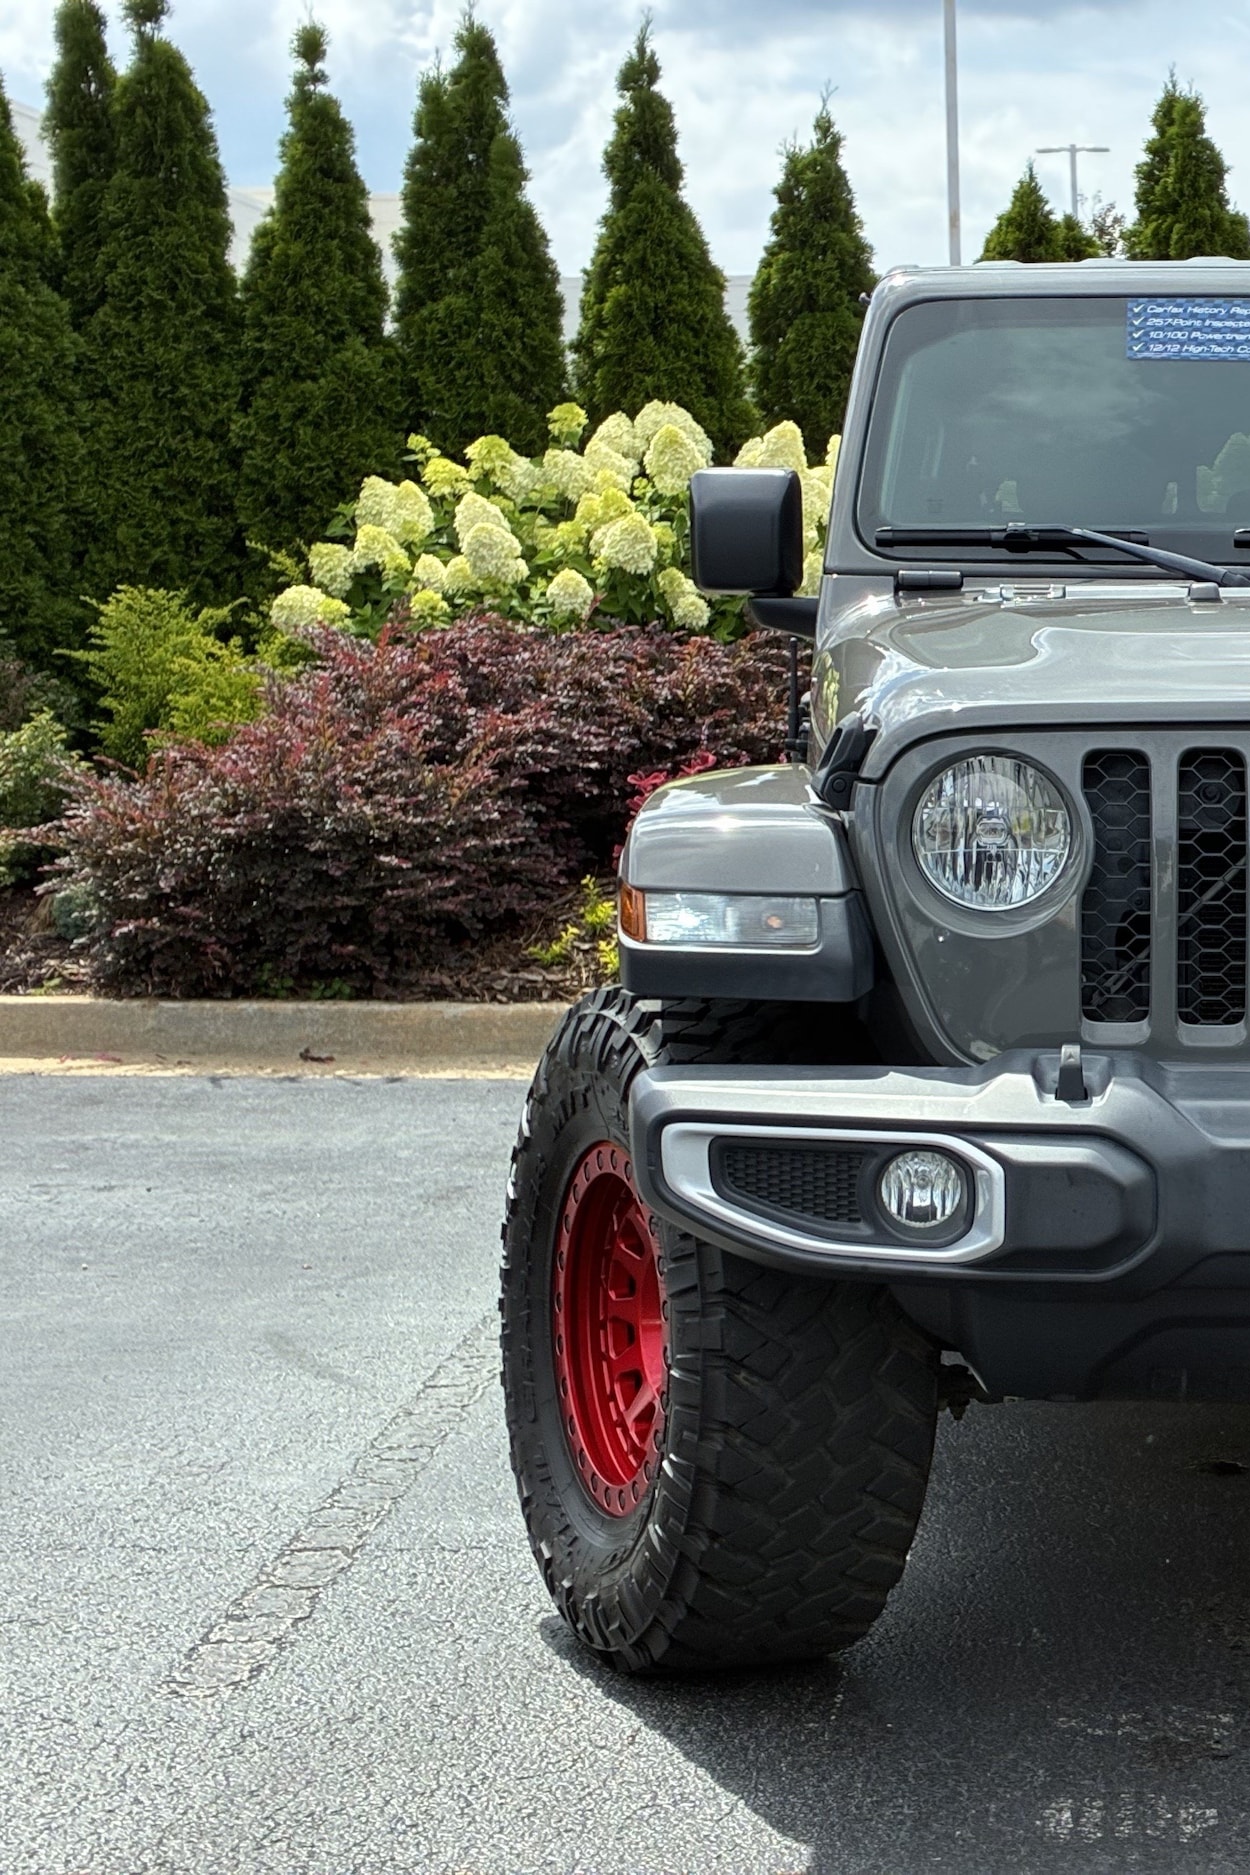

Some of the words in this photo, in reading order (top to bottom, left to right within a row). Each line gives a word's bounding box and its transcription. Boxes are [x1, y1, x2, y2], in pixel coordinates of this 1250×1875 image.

[1146, 305, 1184, 314] Carfax
[1187, 305, 1227, 316] History
[1148, 331, 1189, 340] 10/100
[1148, 343, 1180, 352] 12/12
